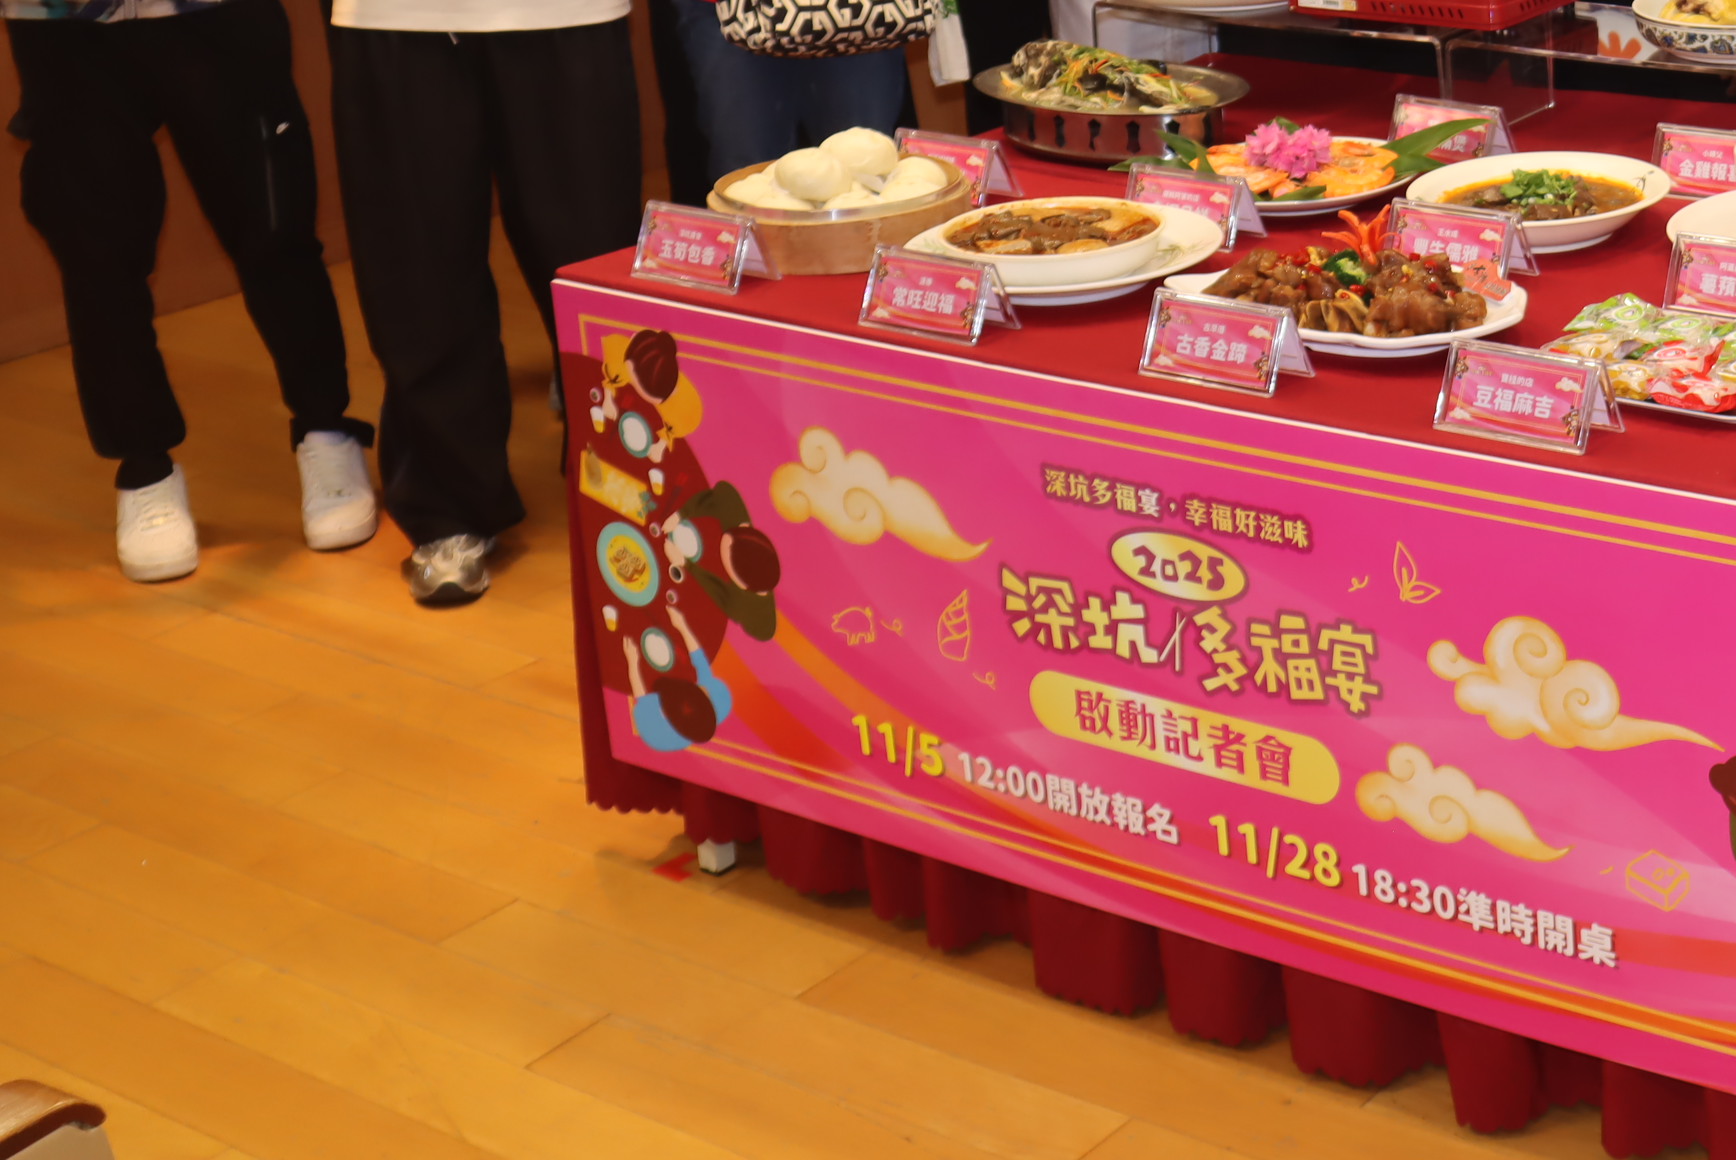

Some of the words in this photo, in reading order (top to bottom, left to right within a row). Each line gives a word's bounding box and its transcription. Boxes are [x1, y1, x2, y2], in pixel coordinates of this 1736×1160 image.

[658, 239, 716, 266] 玉筍包香
[891, 287, 956, 315] 常旺迎福
[1175, 333, 1248, 365] 古香金蹄
[1472, 384, 1555, 419] 豆福麻吉
[1044, 468, 1309, 548] 深坑多福宴，幸福好滋味
[1132, 545, 1225, 591] 2025
[1074, 688, 1293, 787] 啟動記者會
[852, 714, 944, 777] 11/5
[958, 752, 1180, 845] 12:00開放報名
[1209, 814, 1342, 888] 11/28
[1351, 864, 1617, 968] 18:30準時開桌
